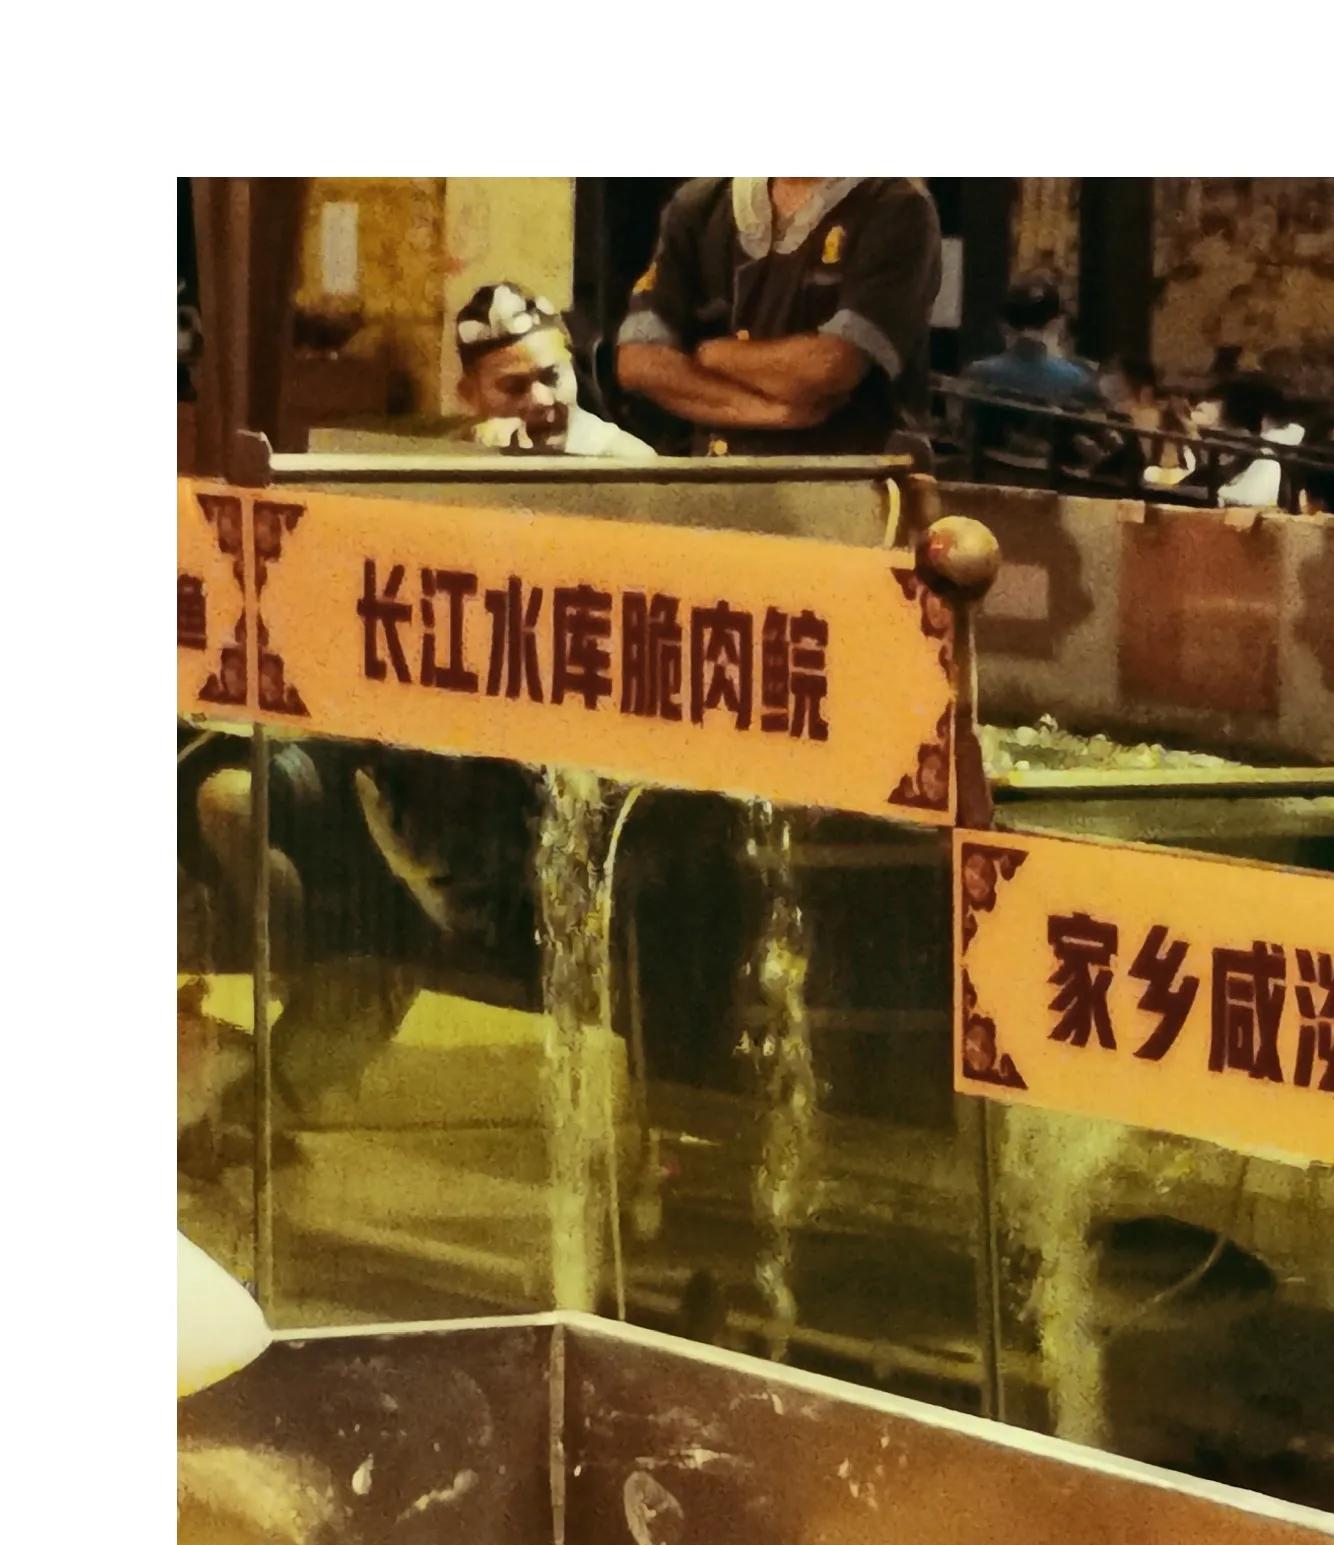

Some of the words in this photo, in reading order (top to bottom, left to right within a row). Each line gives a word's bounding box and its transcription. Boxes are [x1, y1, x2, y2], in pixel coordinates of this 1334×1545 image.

[357, 558, 829, 742] 长江水库脆肉鲩
